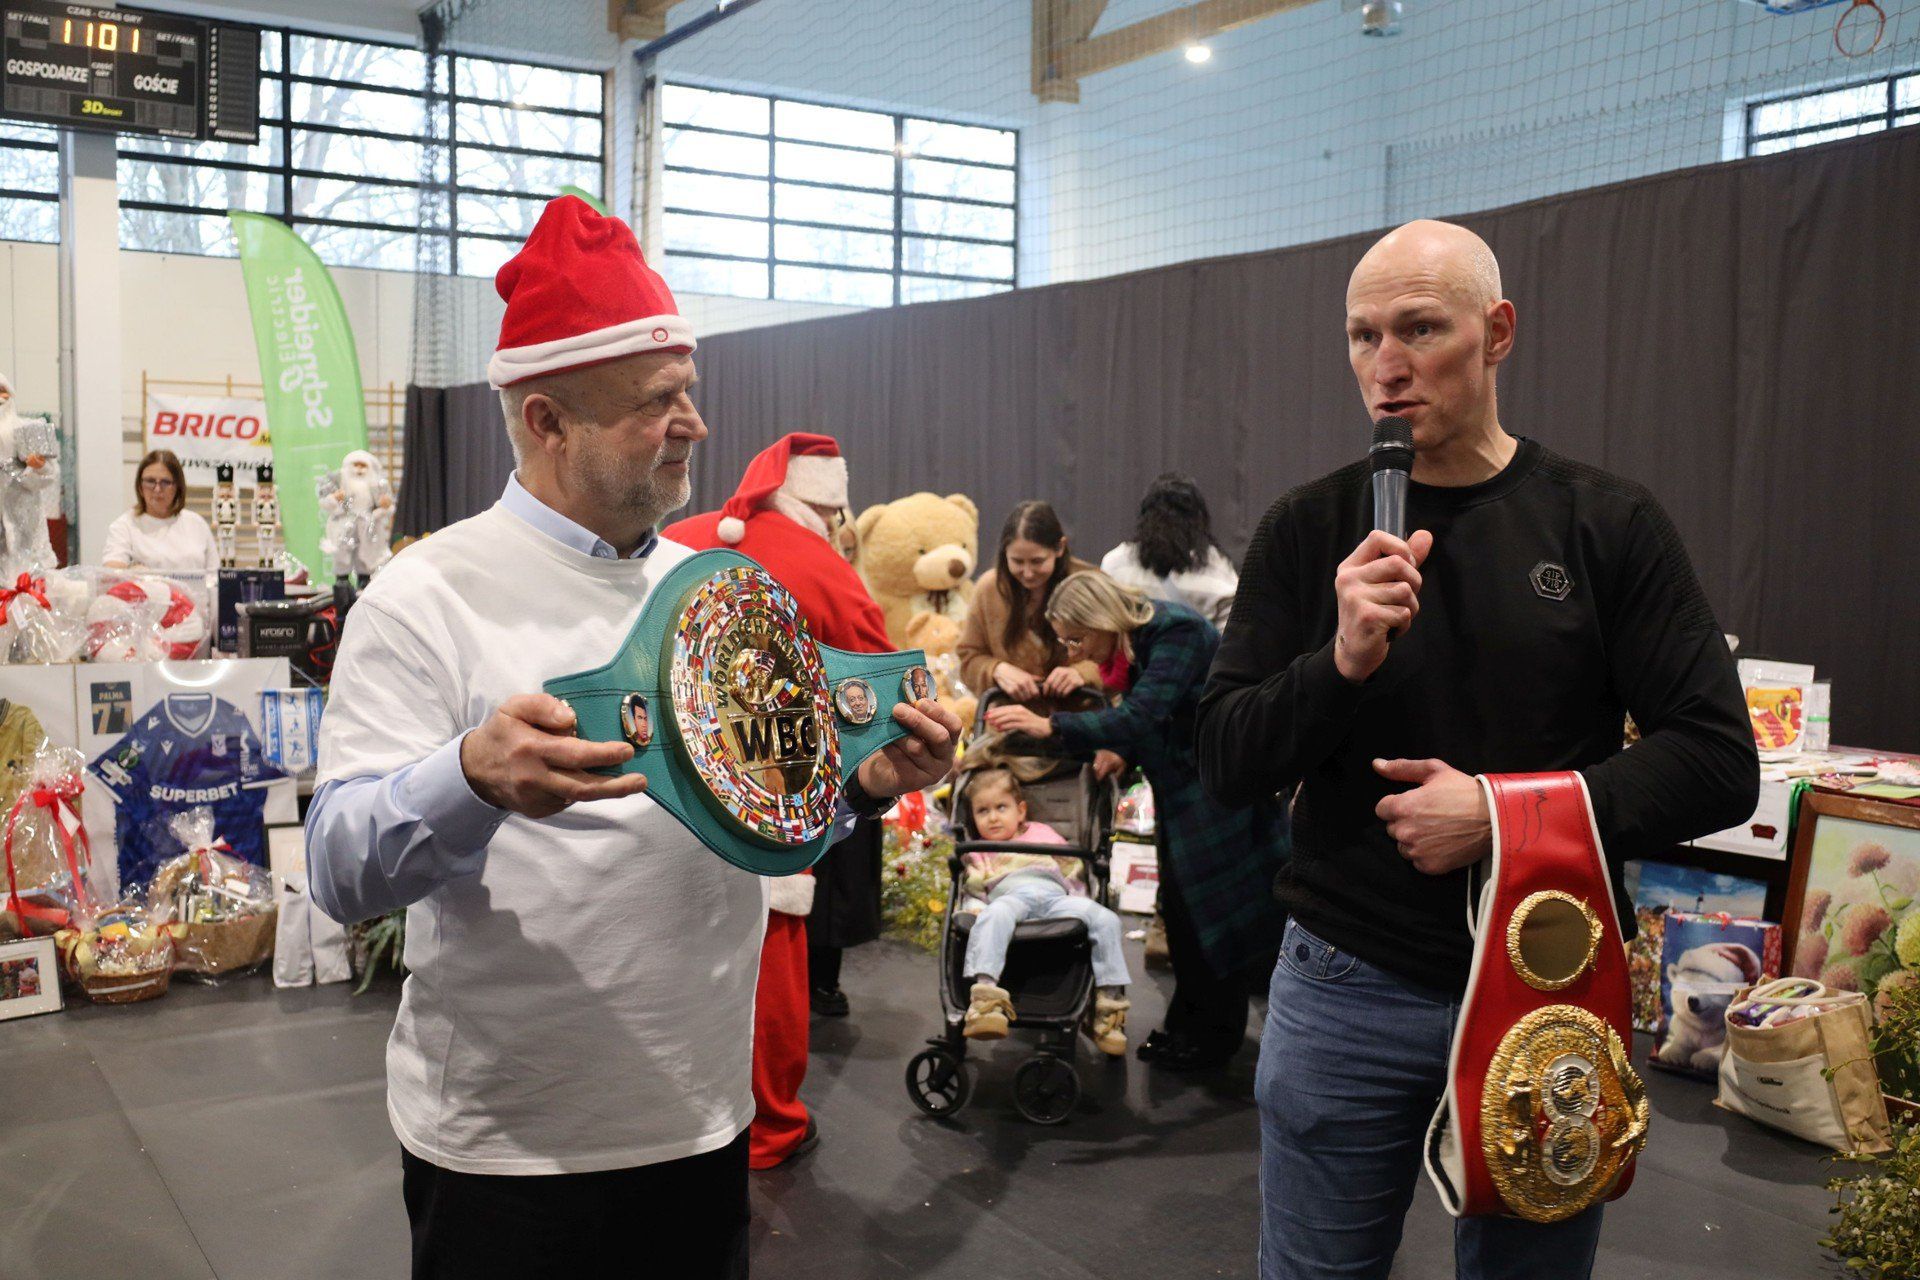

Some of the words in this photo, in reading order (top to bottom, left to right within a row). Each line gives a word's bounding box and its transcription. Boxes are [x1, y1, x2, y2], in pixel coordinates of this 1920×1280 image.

[66, 5, 91, 17] CZAS
[97, 9, 123, 21] CZAS
[122, 13, 144, 24] GRY
[6, 58, 90, 83] GOSPODARZE
[133, 72, 180, 95] GOŚCIE
[153, 411, 260, 440] BRICO
[713, 629, 743, 708] WORLD
[738, 616, 814, 702] CHAMPION
[98, 691, 124, 700] PALMA
[730, 715, 819, 765] WBC
[149, 782, 238, 803] SUPERBET
